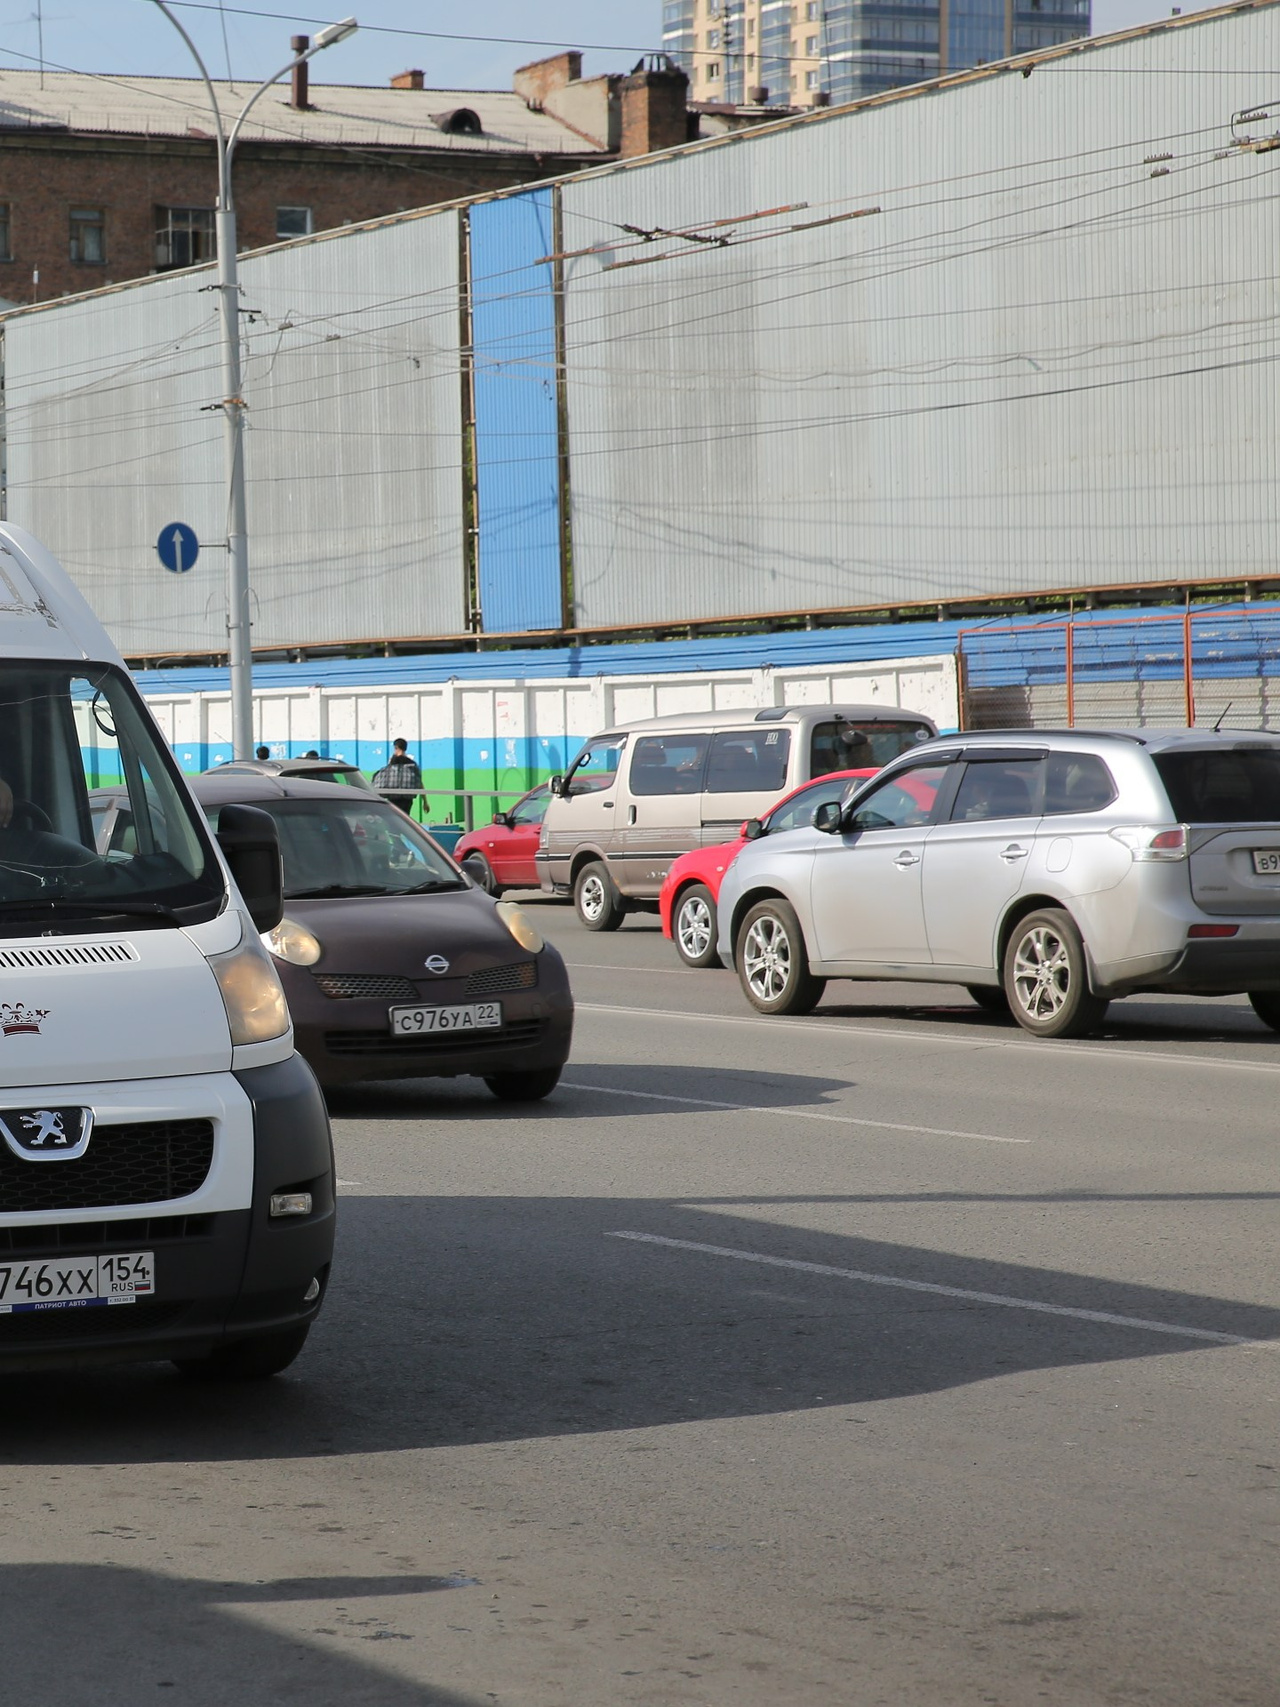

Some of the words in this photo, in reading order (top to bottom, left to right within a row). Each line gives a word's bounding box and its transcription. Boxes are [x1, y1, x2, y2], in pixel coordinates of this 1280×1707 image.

[477, 1005, 494, 1019] 22
[401, 1009, 473, 1031] С976УА
[102, 1255, 148, 1282] 154
[111, 1282, 134, 1292] RUS
[34, 1300, 67, 1310] ПАТРИОТ
[68, 1299, 87, 1308] АВТО
